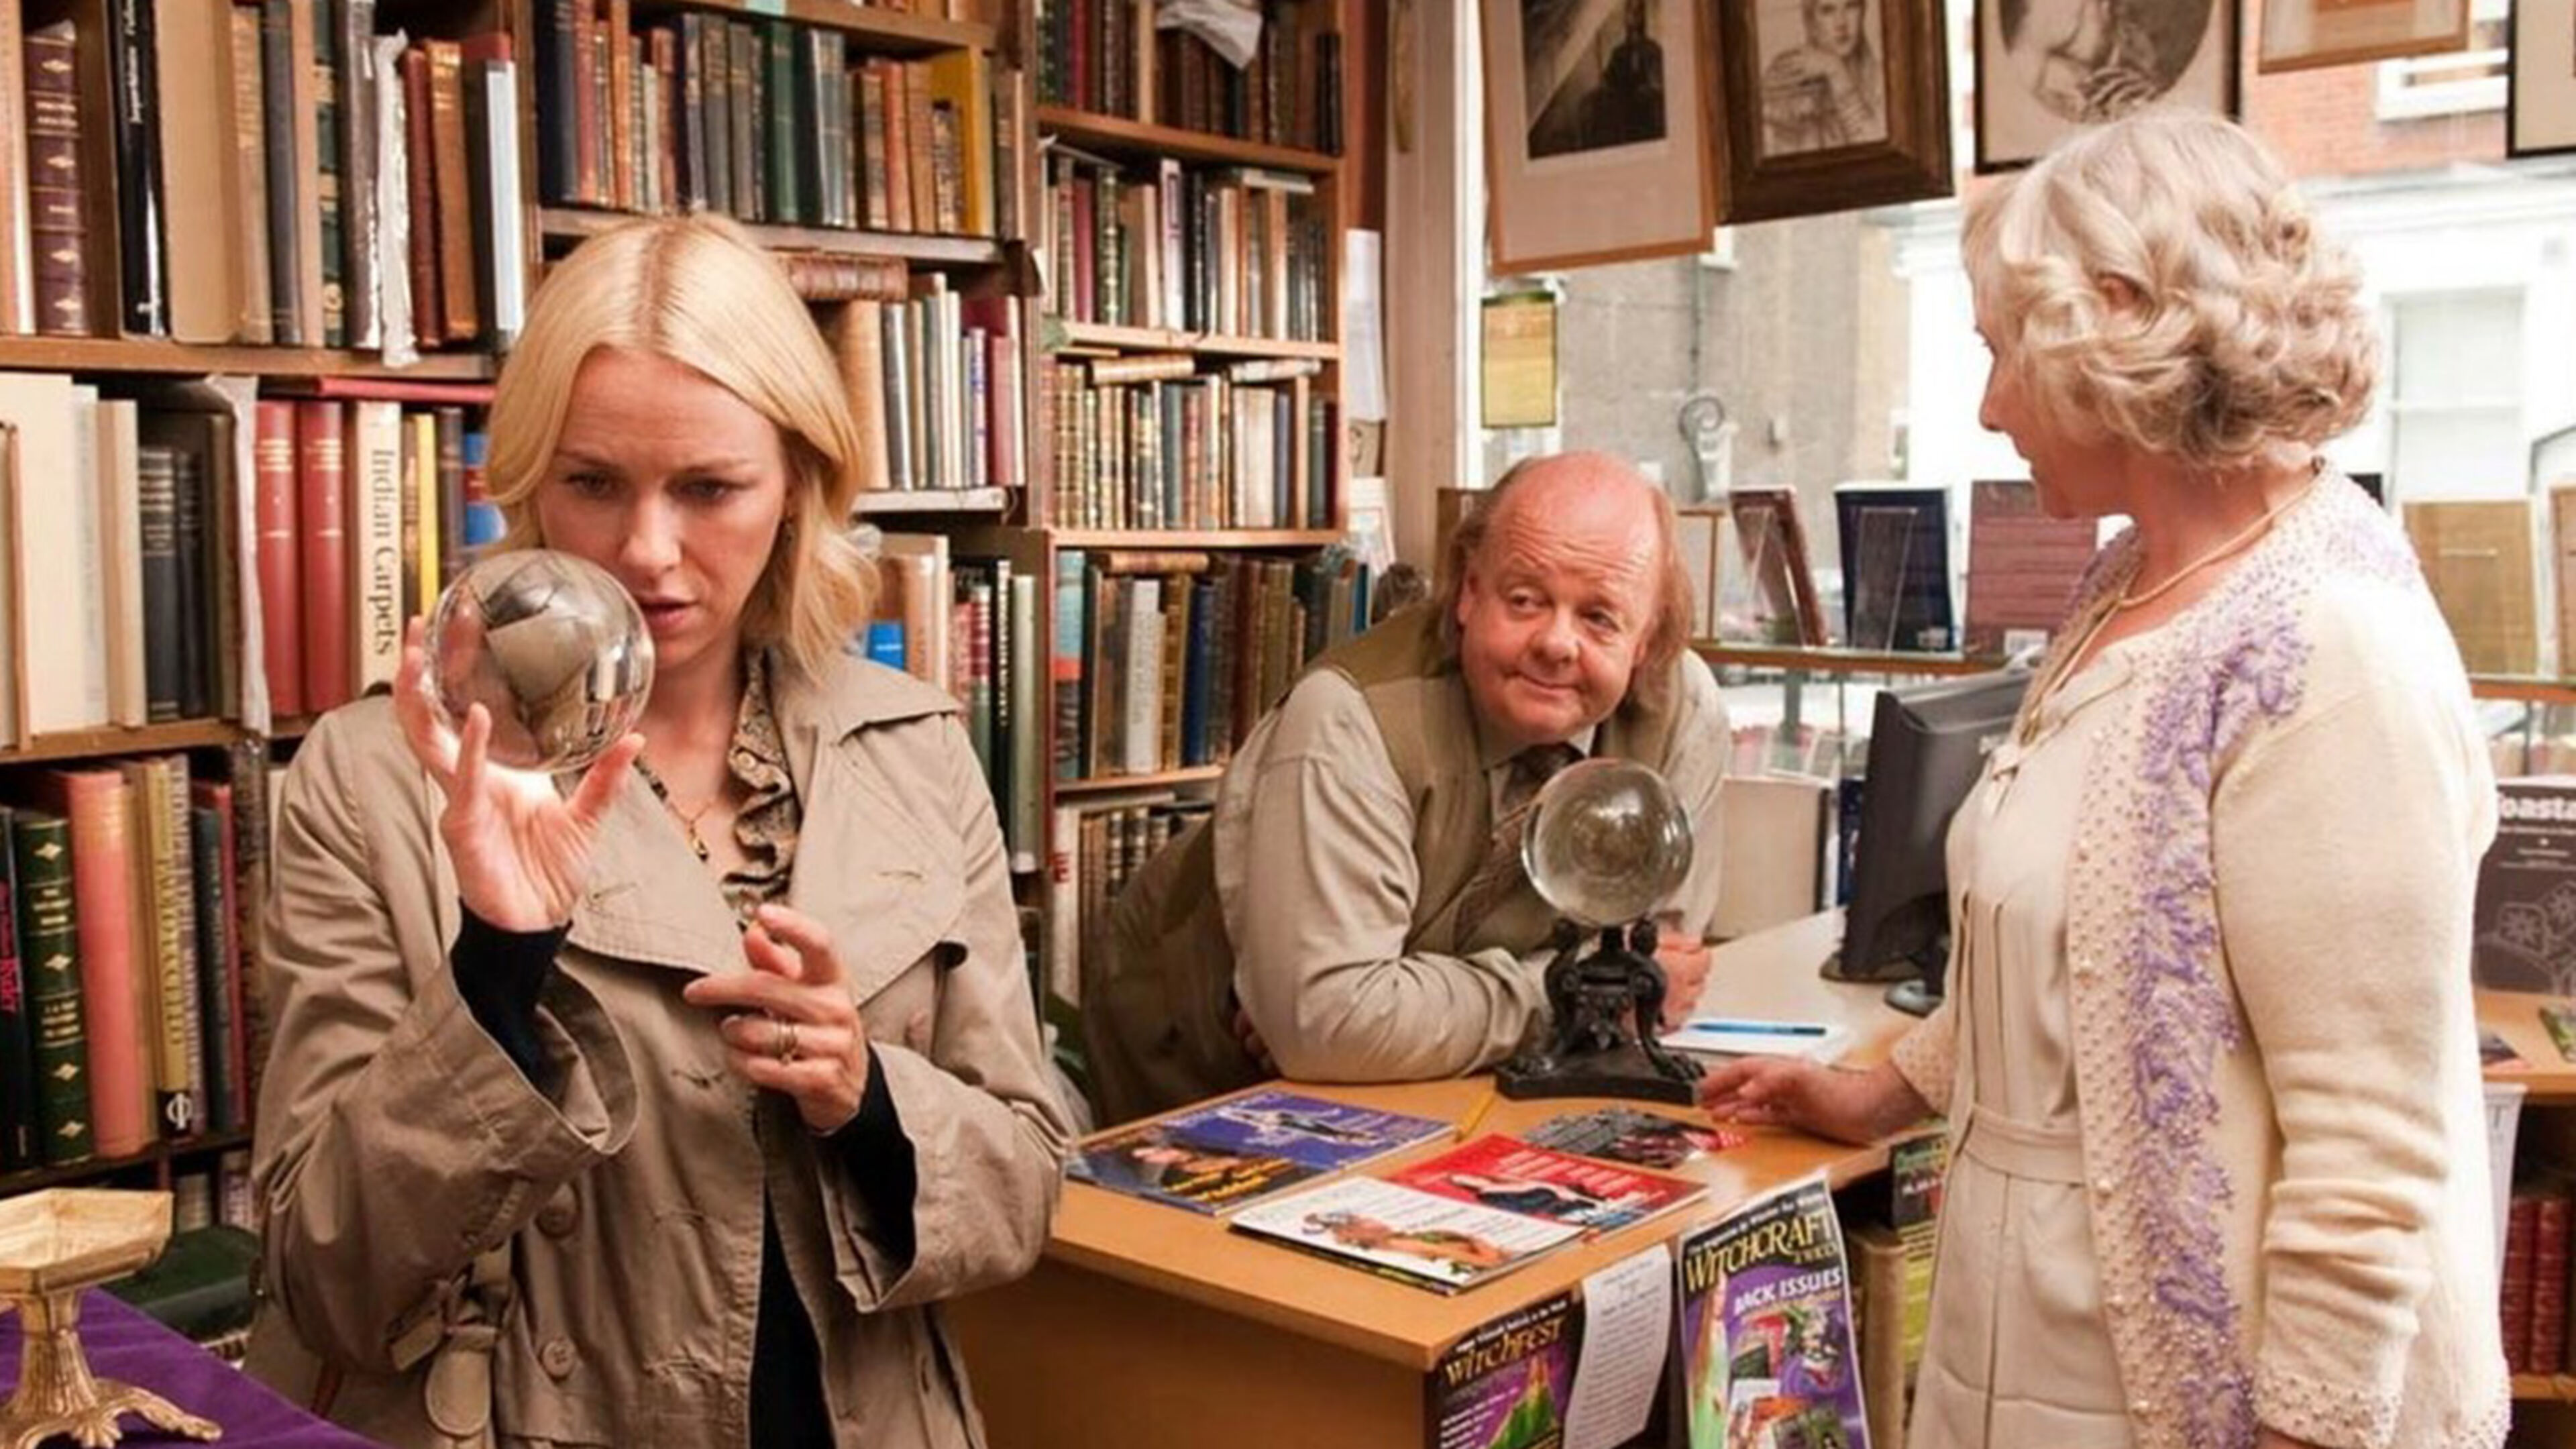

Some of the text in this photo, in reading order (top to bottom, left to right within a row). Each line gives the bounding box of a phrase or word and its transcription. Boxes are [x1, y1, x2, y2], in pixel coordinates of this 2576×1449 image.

[367, 449, 396, 655] Indian Carpets
[1686, 1208, 1831, 1293] WITCHCRAFT
[1780, 1267, 1842, 1297] ISSUES
